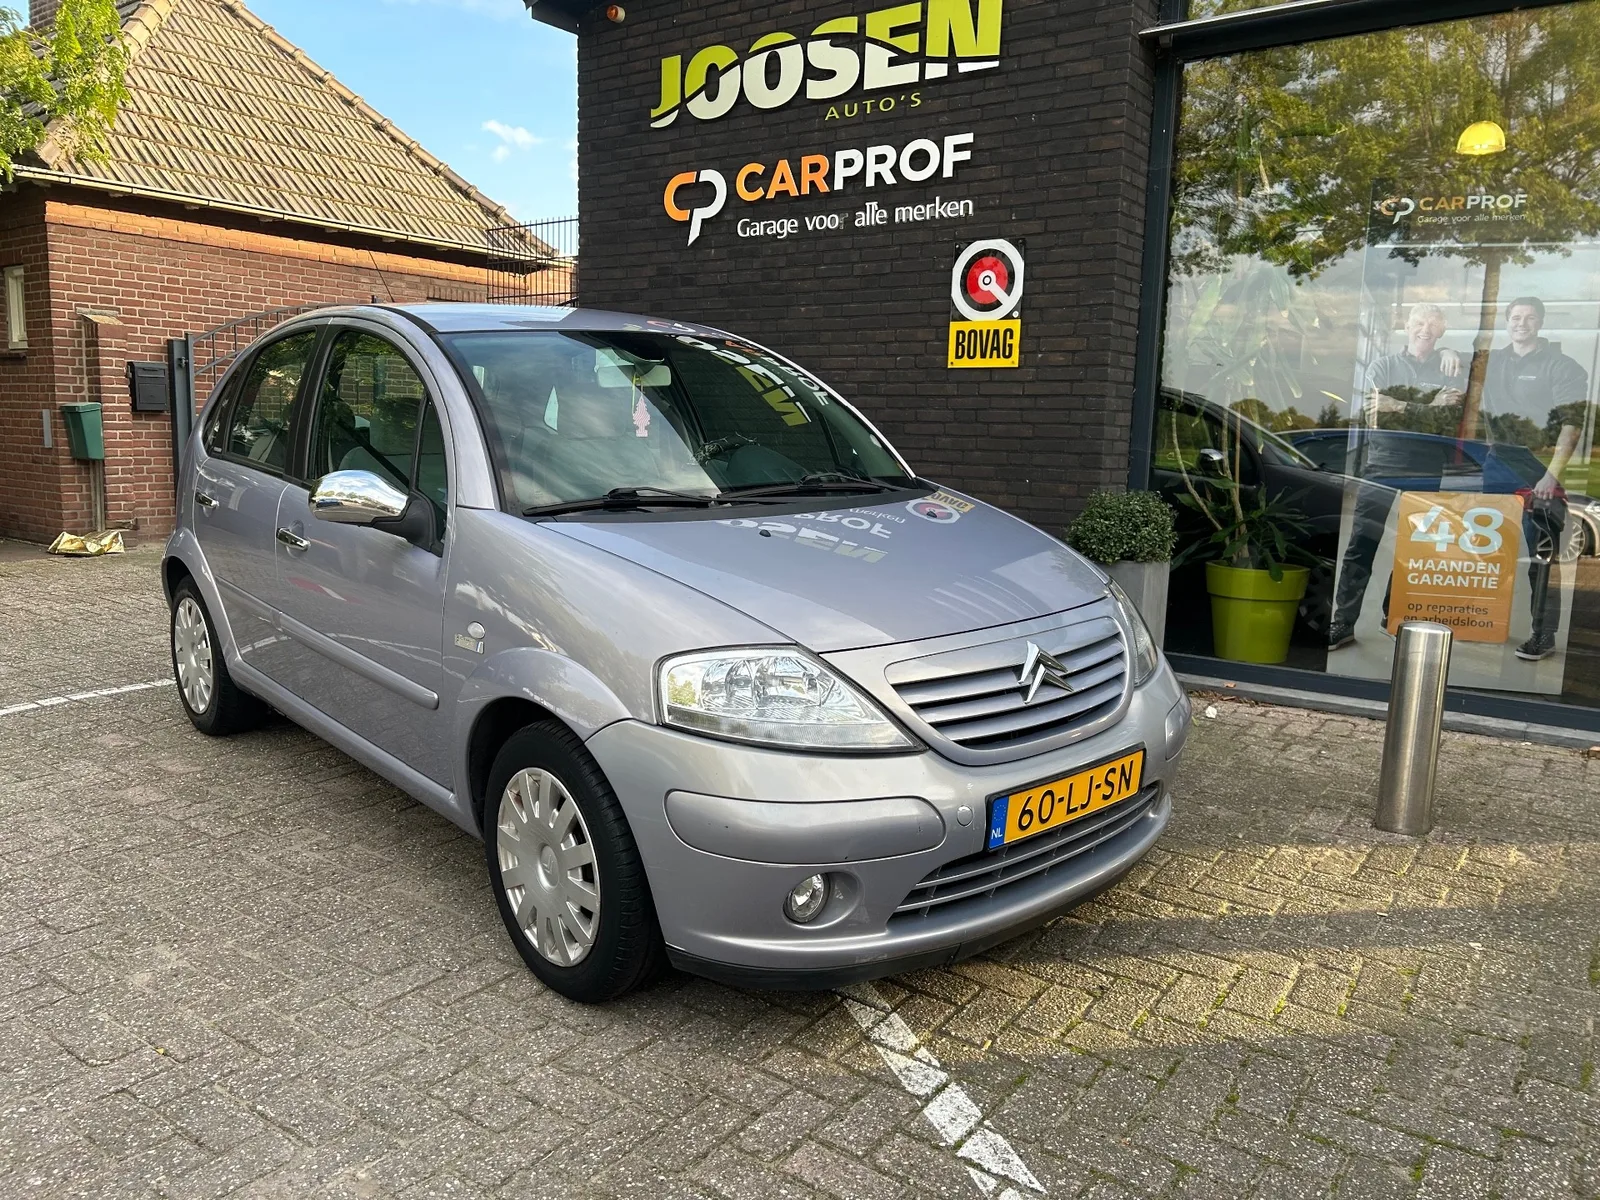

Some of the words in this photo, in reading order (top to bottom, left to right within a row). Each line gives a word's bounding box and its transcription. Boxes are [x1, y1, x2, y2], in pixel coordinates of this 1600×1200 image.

[650, 0, 1002, 128] JOOSEN
[824, 92, 922, 121] AUTO'S
[735, 132, 975, 202] CARPROF
[1419, 194, 1528, 211] CARPROF
[737, 218, 799, 239] Garage
[894, 196, 974, 223] merken
[1418, 215, 1449, 225] Garage
[1451, 214, 1471, 224] voor
[1474, 213, 1489, 222] alle
[1492, 213, 1526, 222] merken
[955, 328, 1014, 360] BOVAG
[1410, 506, 1504, 555] 48
[1407, 573, 1499, 589] GARANTIE
[1408, 558, 1500, 575] MAANDEN
[1407, 602, 1423, 613] op
[1426, 603, 1489, 615] reparaties
[1017, 759, 1134, 831] 60-LJ-SN
[990, 828, 1003, 840] NL
